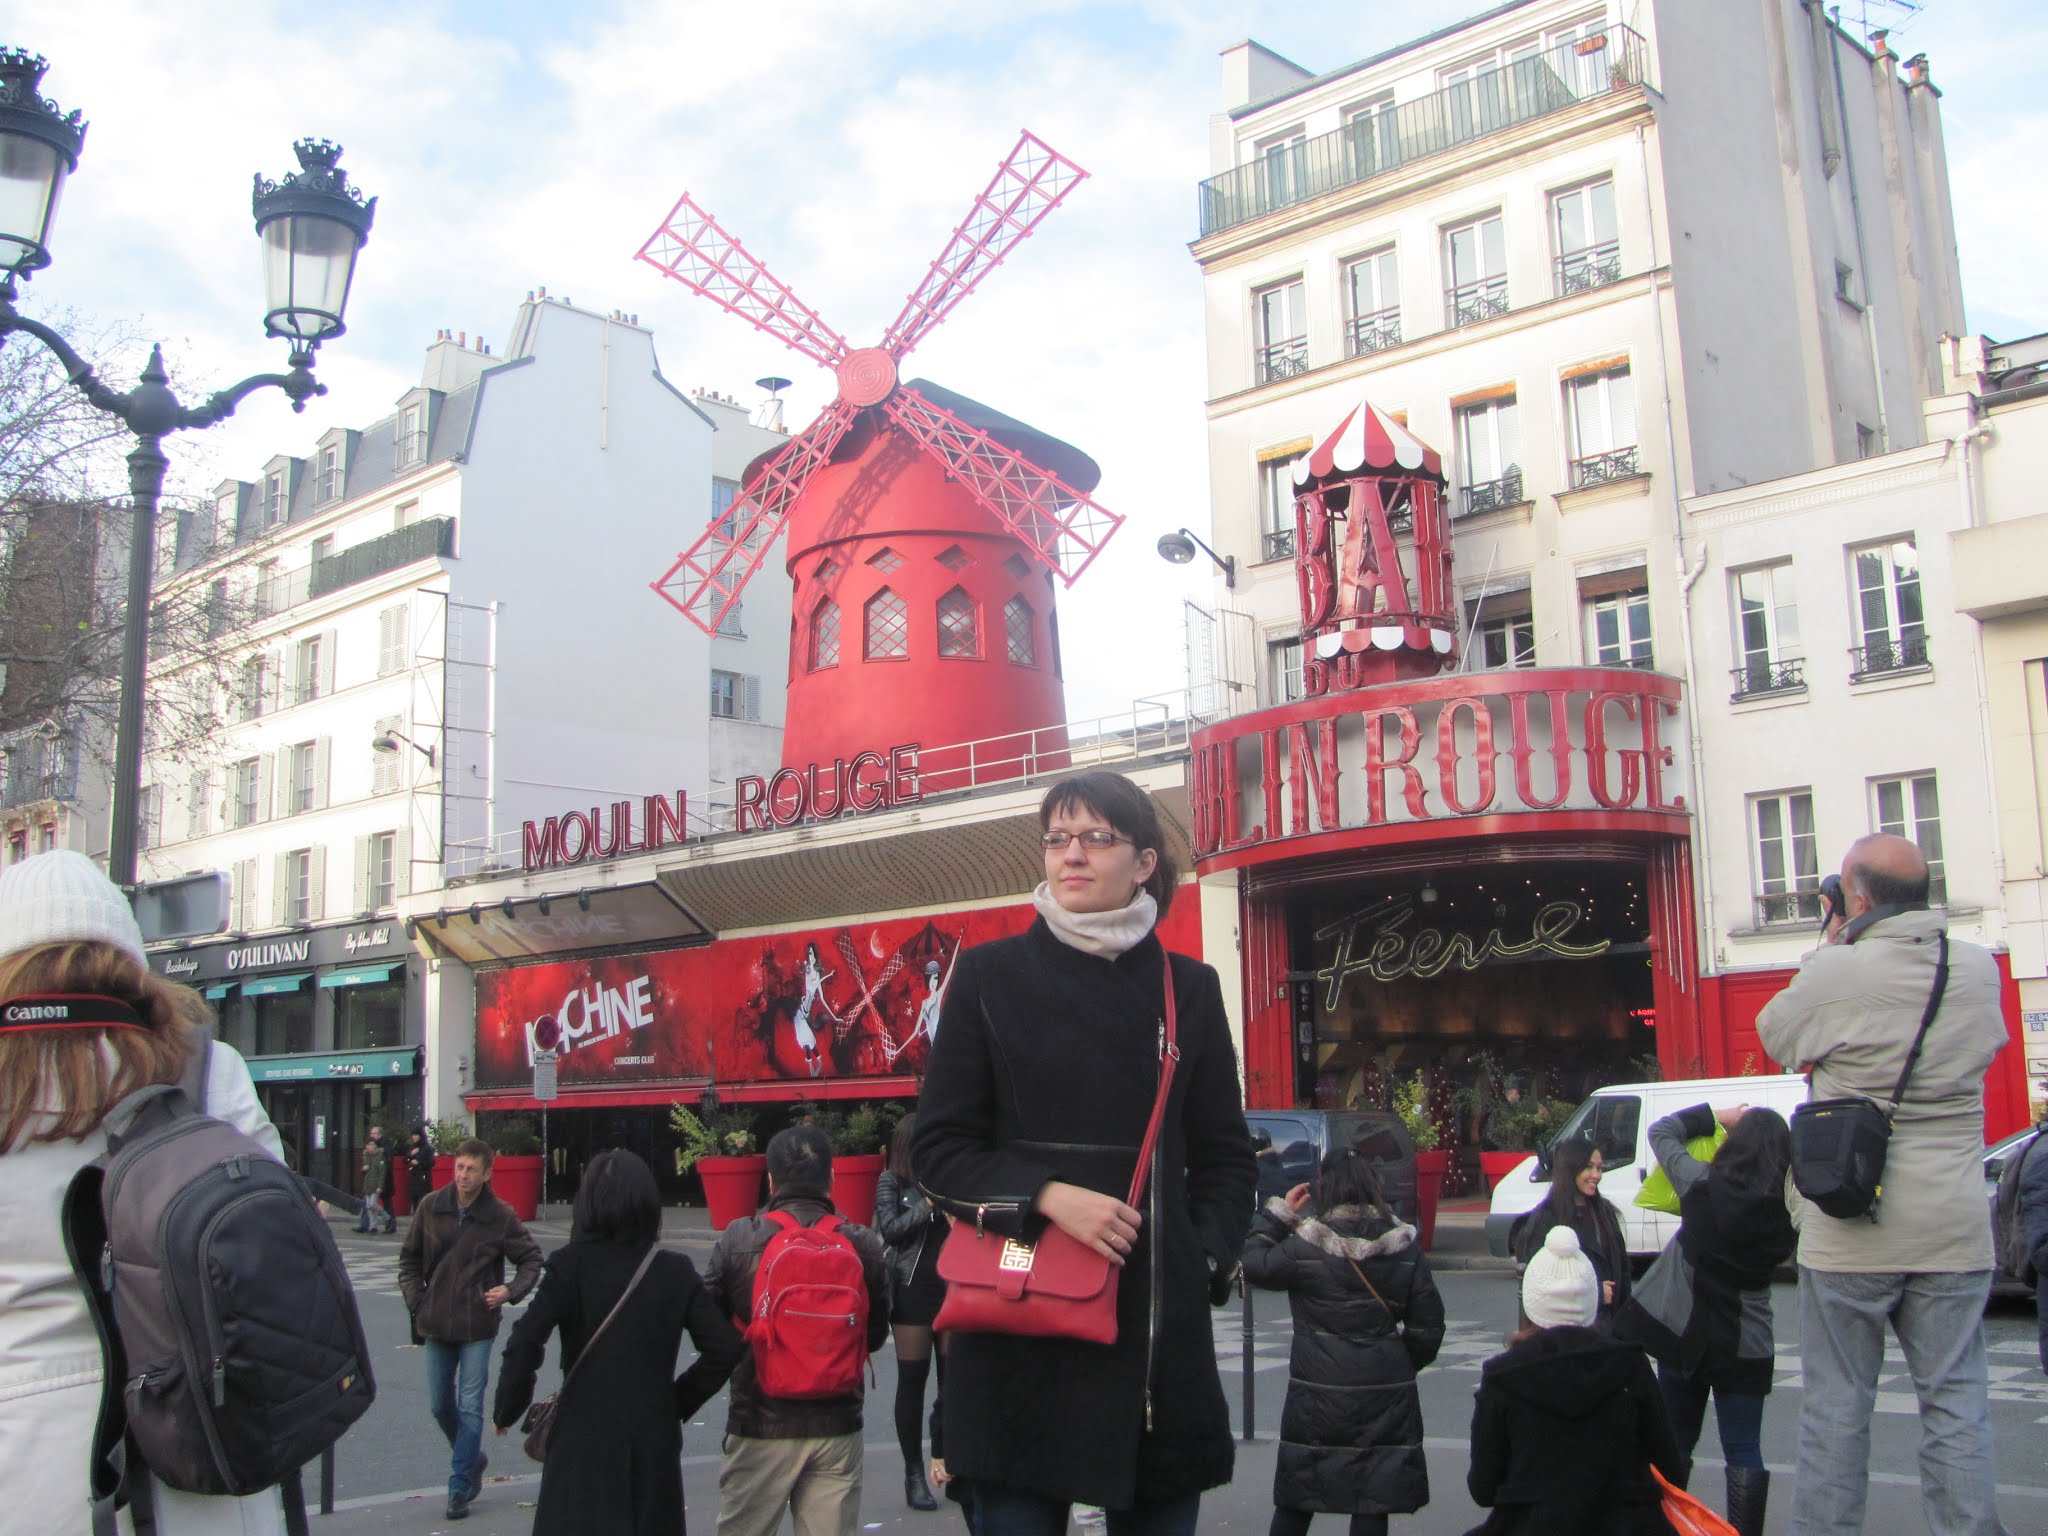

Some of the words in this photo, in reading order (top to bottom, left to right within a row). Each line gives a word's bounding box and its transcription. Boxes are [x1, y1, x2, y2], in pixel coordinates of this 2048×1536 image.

[1295, 476, 1457, 636] BAL
[1304, 653, 1361, 697] DU
[1363, 690, 1685, 824] ROUGE
[522, 789, 687, 871] MOULIN
[735, 743, 920, 833] ROUGE
[229, 940, 310, 968] O'SULLIVANS
[345, 933, 357, 953] By
[357, 932, 371, 948] the
[371, 927, 389, 946] Mill
[165, 959, 198, 976] Backstage
[7, 1005, 68, 1021] Canon
